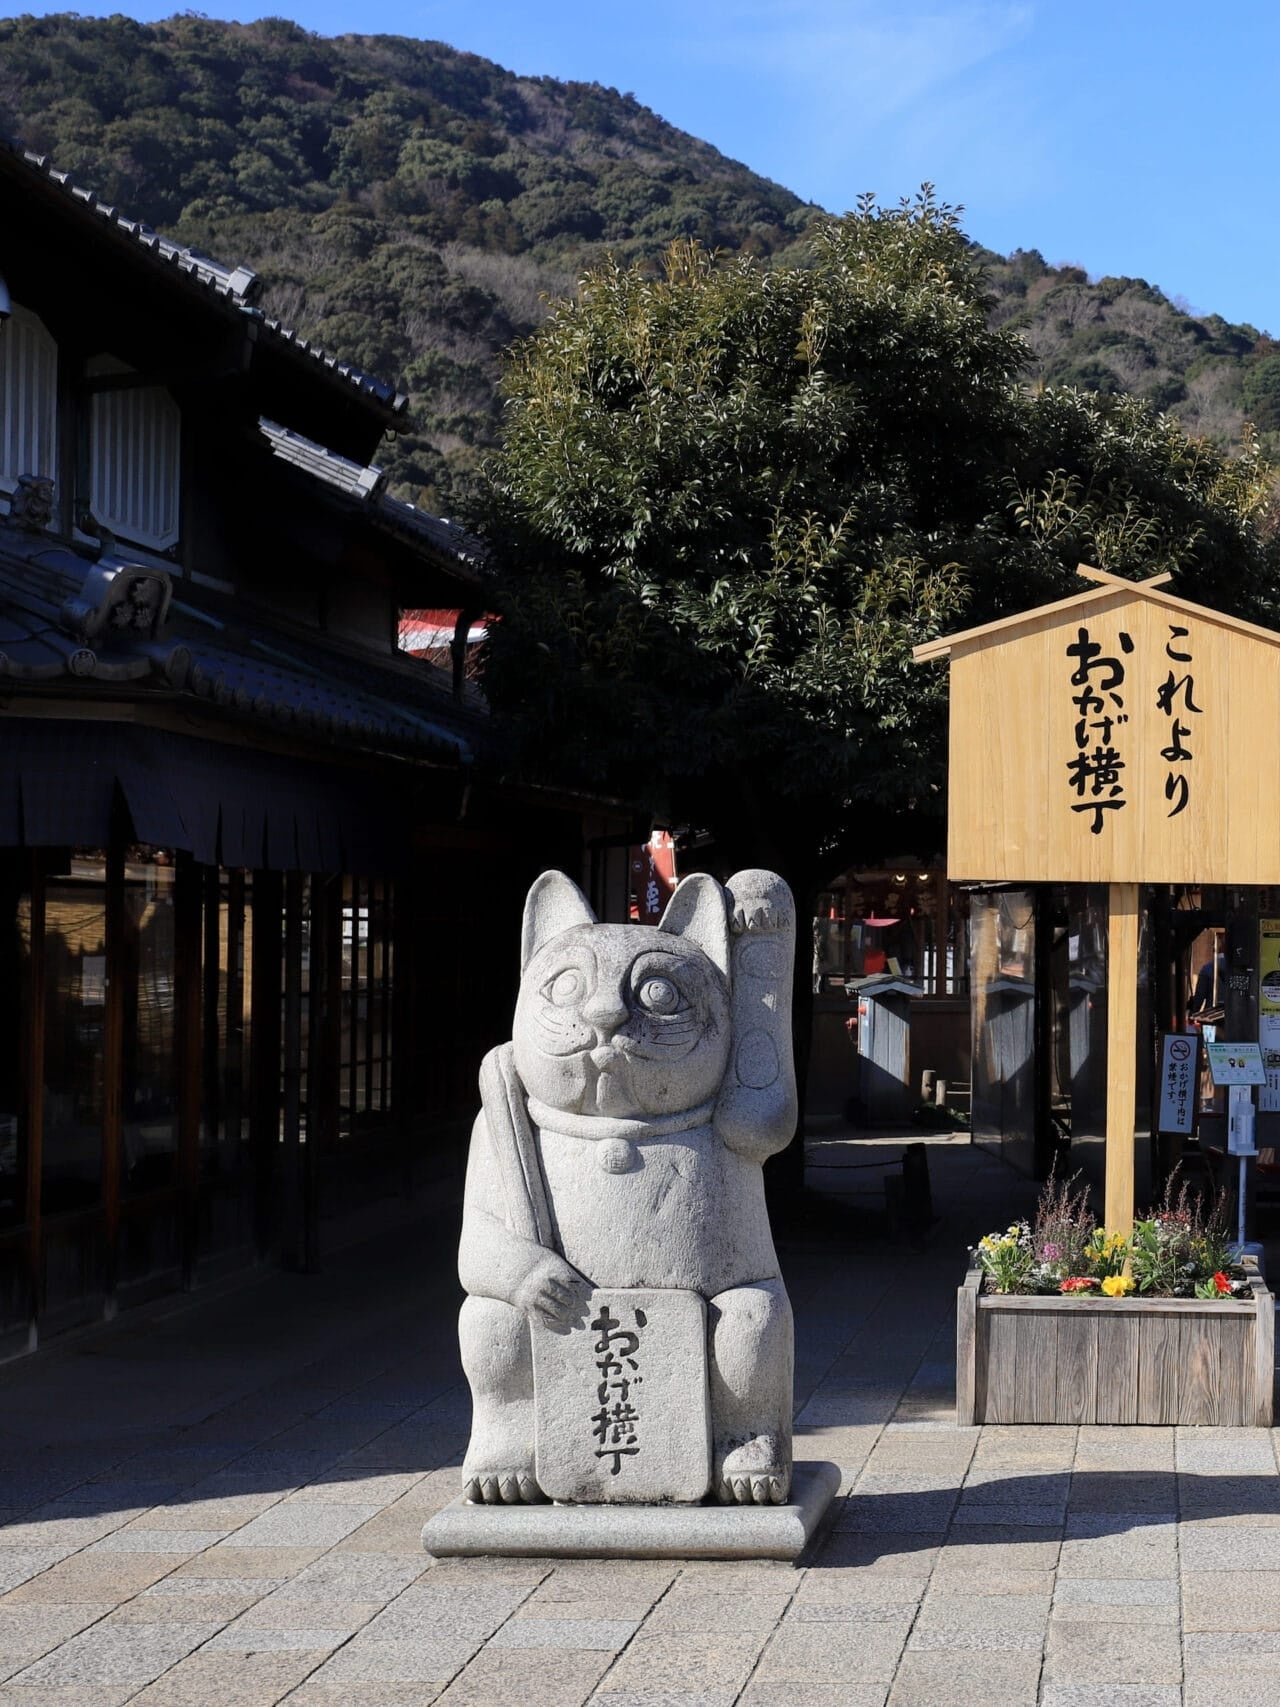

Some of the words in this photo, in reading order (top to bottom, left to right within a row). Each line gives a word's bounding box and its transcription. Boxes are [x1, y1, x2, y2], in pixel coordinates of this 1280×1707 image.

[1066, 627, 1135, 835] おかげ横丁
[1156, 625, 1203, 818] これより
[1177, 1063, 1189, 1126] おかげ横丁内は
[591, 1306, 648, 1475] おかげ横丁
